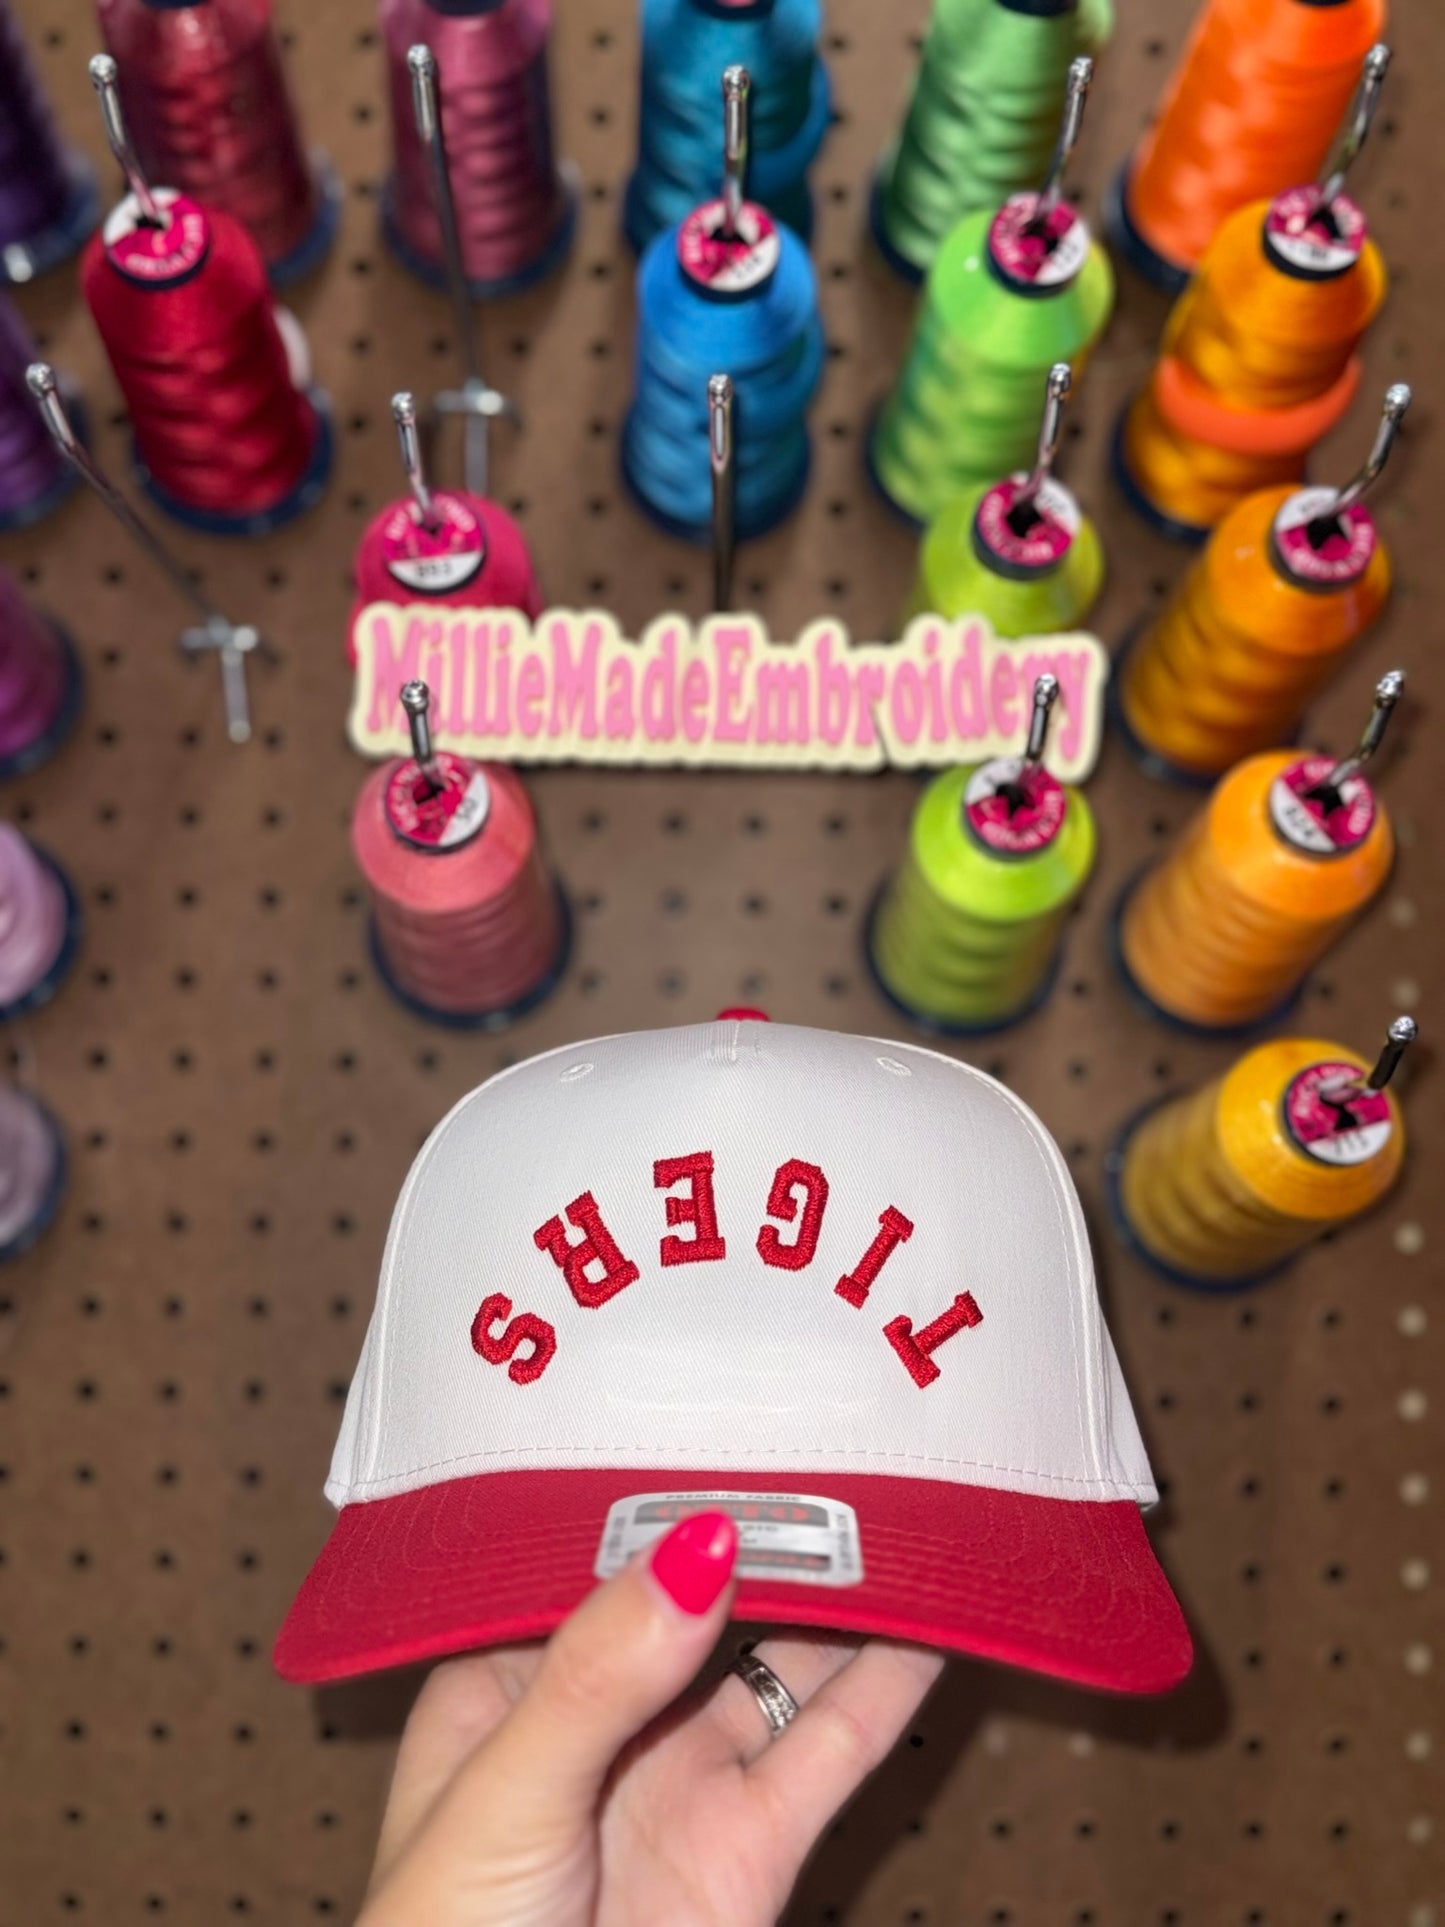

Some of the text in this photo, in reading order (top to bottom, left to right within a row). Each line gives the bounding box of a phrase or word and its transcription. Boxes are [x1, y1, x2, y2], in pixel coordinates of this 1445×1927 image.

[366, 616, 1090, 762] MillieMadeEmbroidery
[471, 1150, 984, 1389] TIGERS
[746, 1494, 801, 1503] FABRIC
